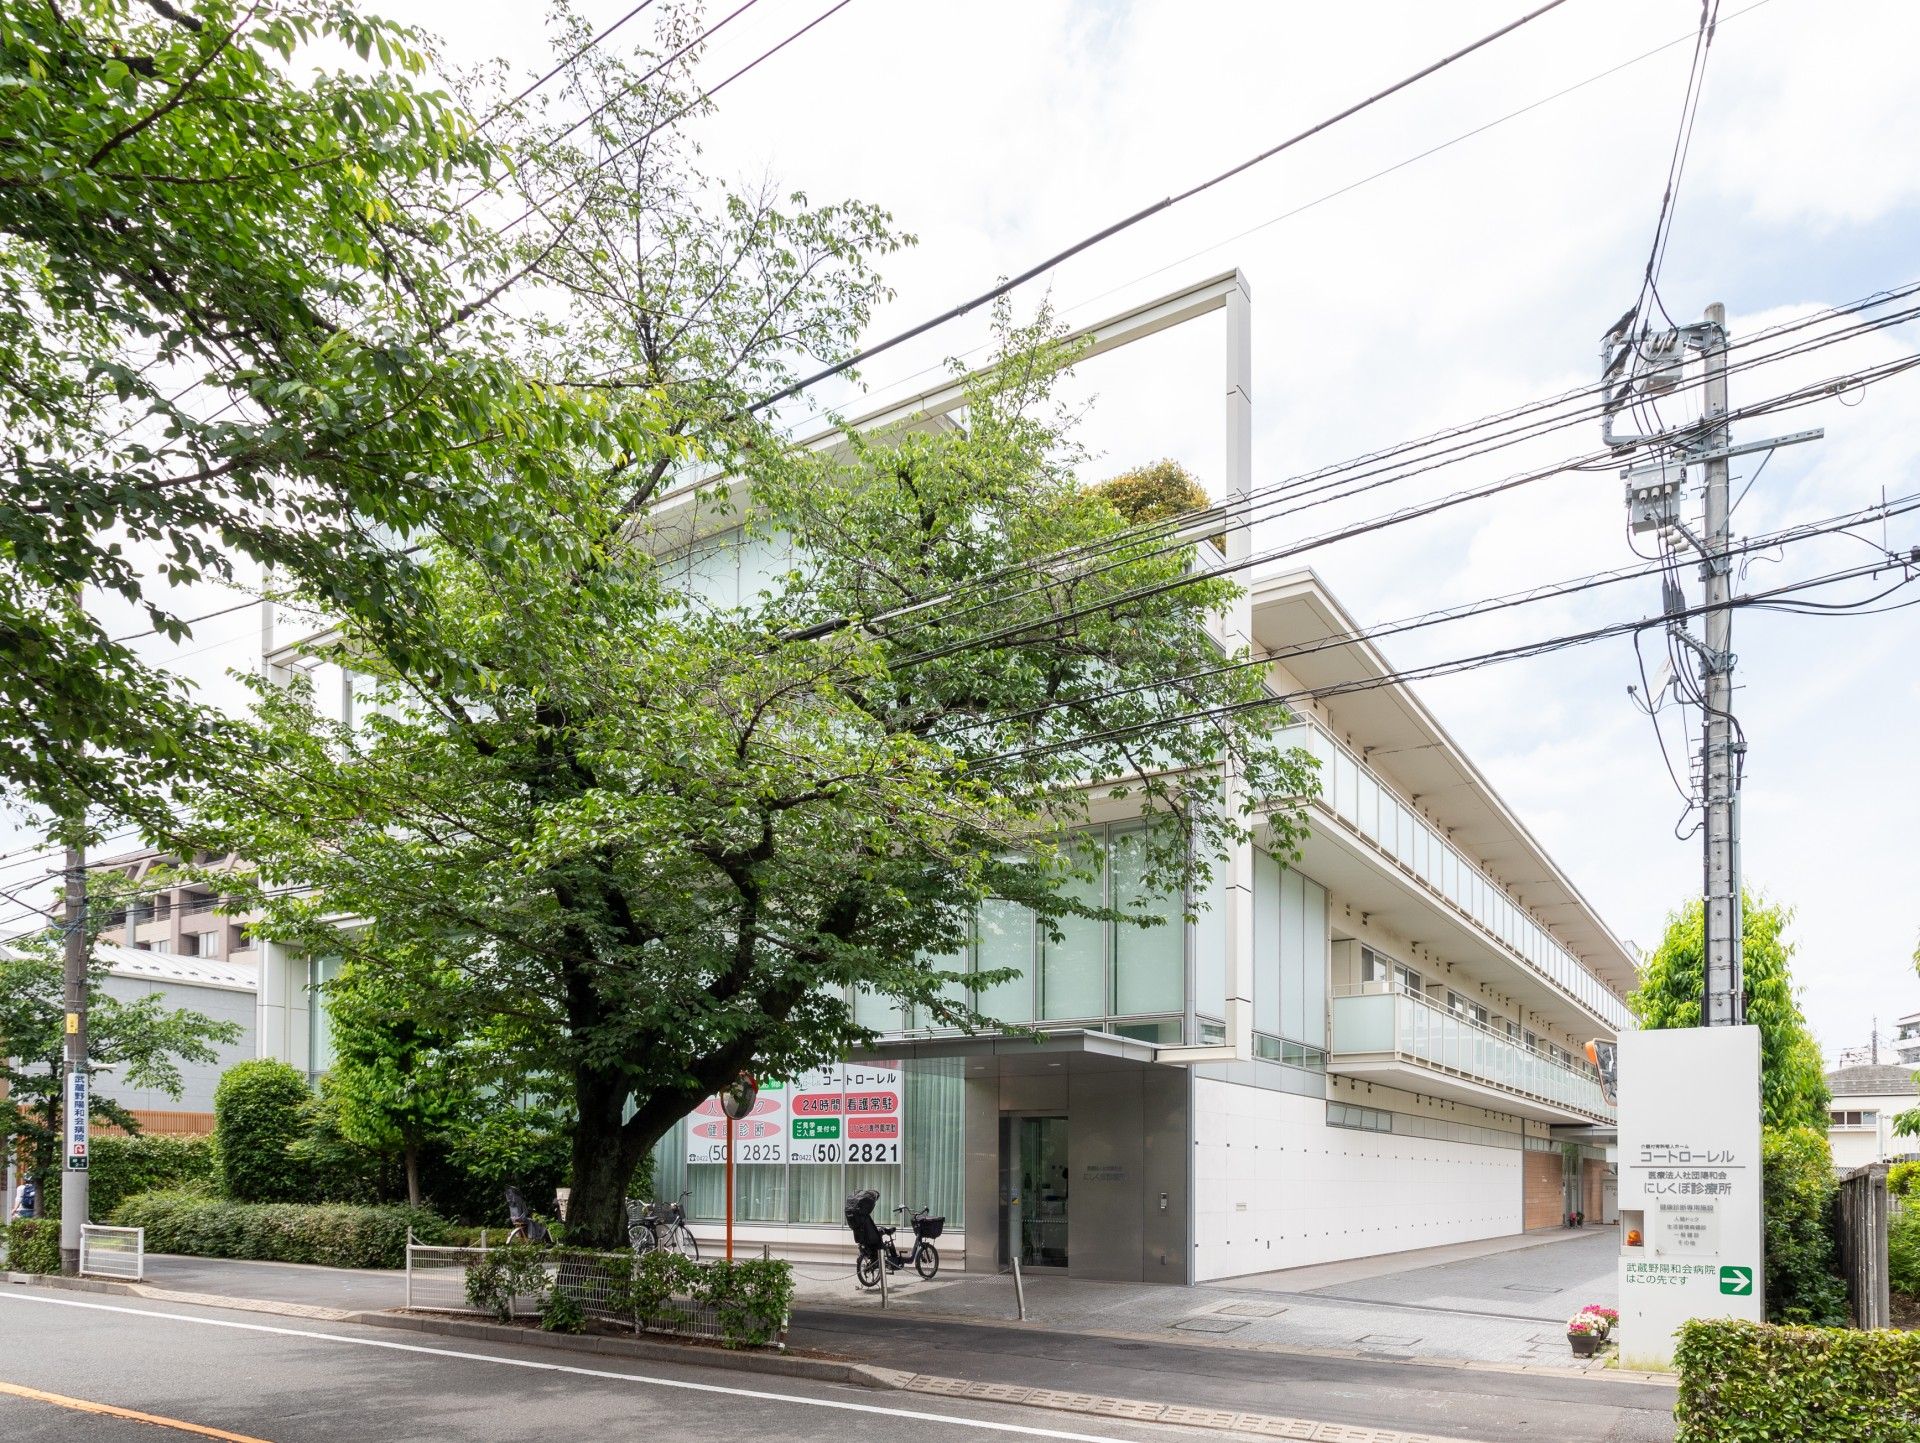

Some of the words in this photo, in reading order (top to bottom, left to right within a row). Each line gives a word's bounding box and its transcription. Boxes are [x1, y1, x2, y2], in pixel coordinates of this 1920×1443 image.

[823, 1073, 896, 1086] コートローレル
[74, 1075, 85, 1142] 武蔵野陽和会病院
[802, 1097, 893, 1112] 24時間看護常駐
[816, 1125, 837, 1133] 受付中
[743, 1145, 781, 1161] 2825
[812, 1144, 841, 1163] (50)
[848, 1144, 897, 1162] 2821
[1640, 1150, 1735, 1163] コートローレル
[1648, 1171, 1727, 1180] 医療法人社団陽和会
[1644, 1182, 1732, 1195] にしくぼ診療所
[1626, 1262, 1716, 1275] 武蔵野陽和会病院
[1626, 1274, 1688, 1285] はこの先です
